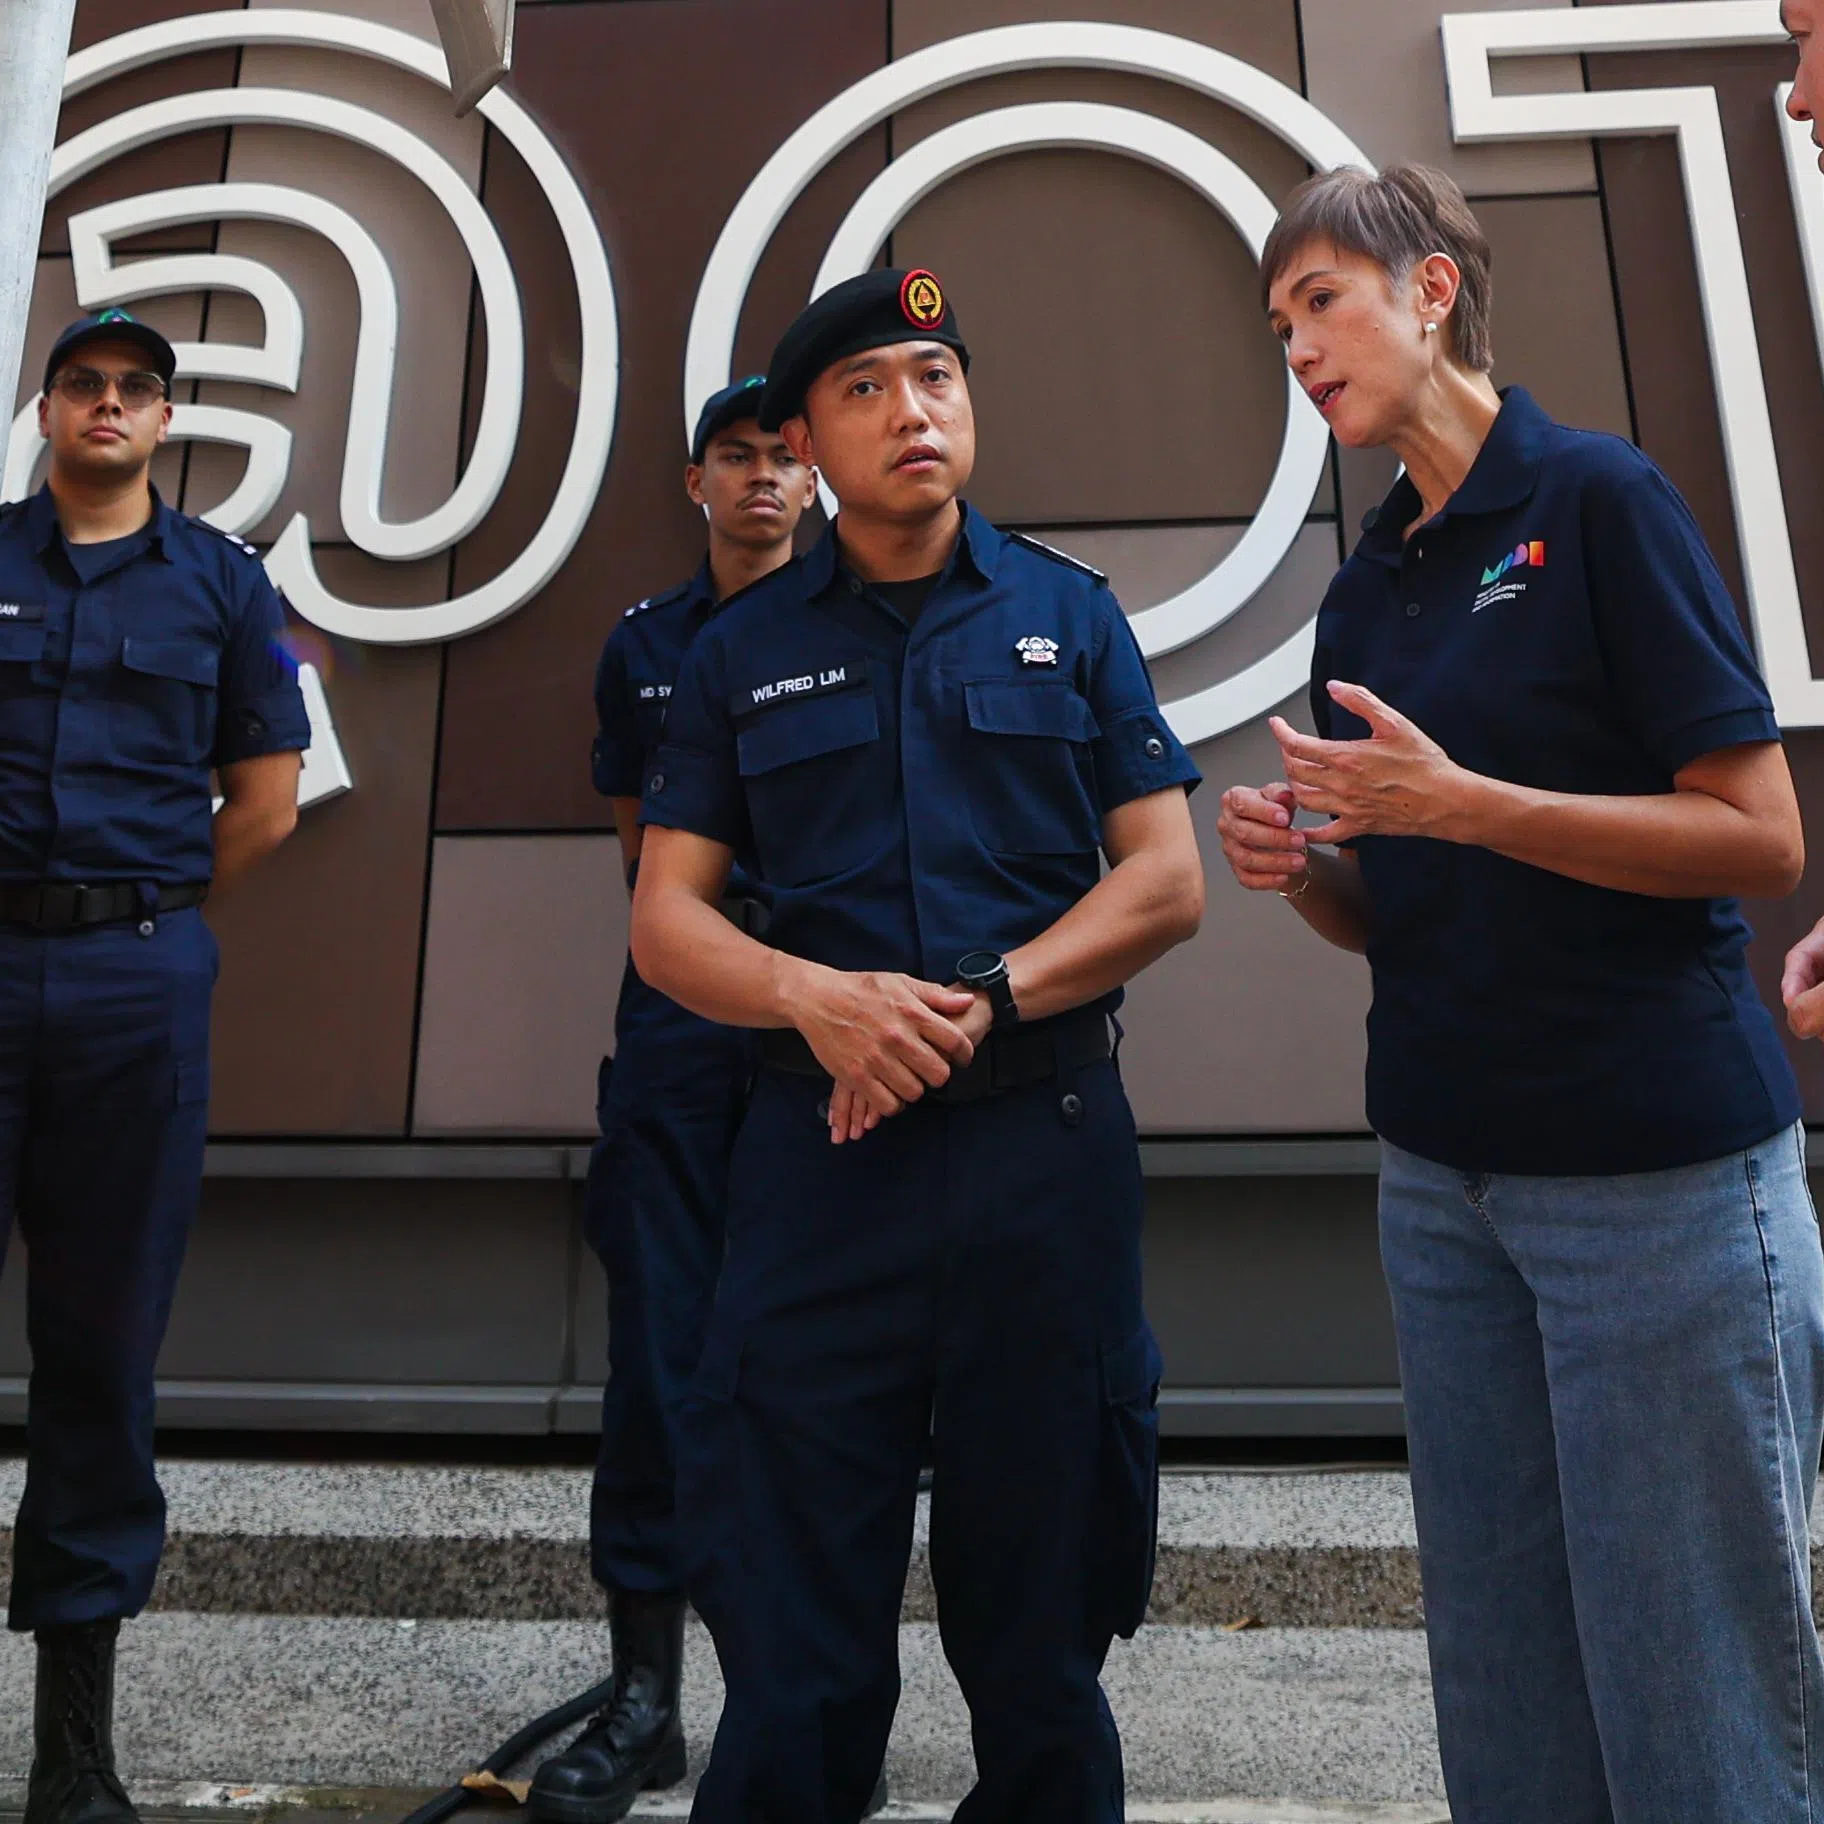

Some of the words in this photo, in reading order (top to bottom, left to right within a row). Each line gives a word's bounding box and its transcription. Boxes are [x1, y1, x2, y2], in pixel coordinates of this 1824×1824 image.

[659, 686, 673, 698] SY
[752, 676, 814, 703] WILFRED
[820, 667, 846, 686] LIM
